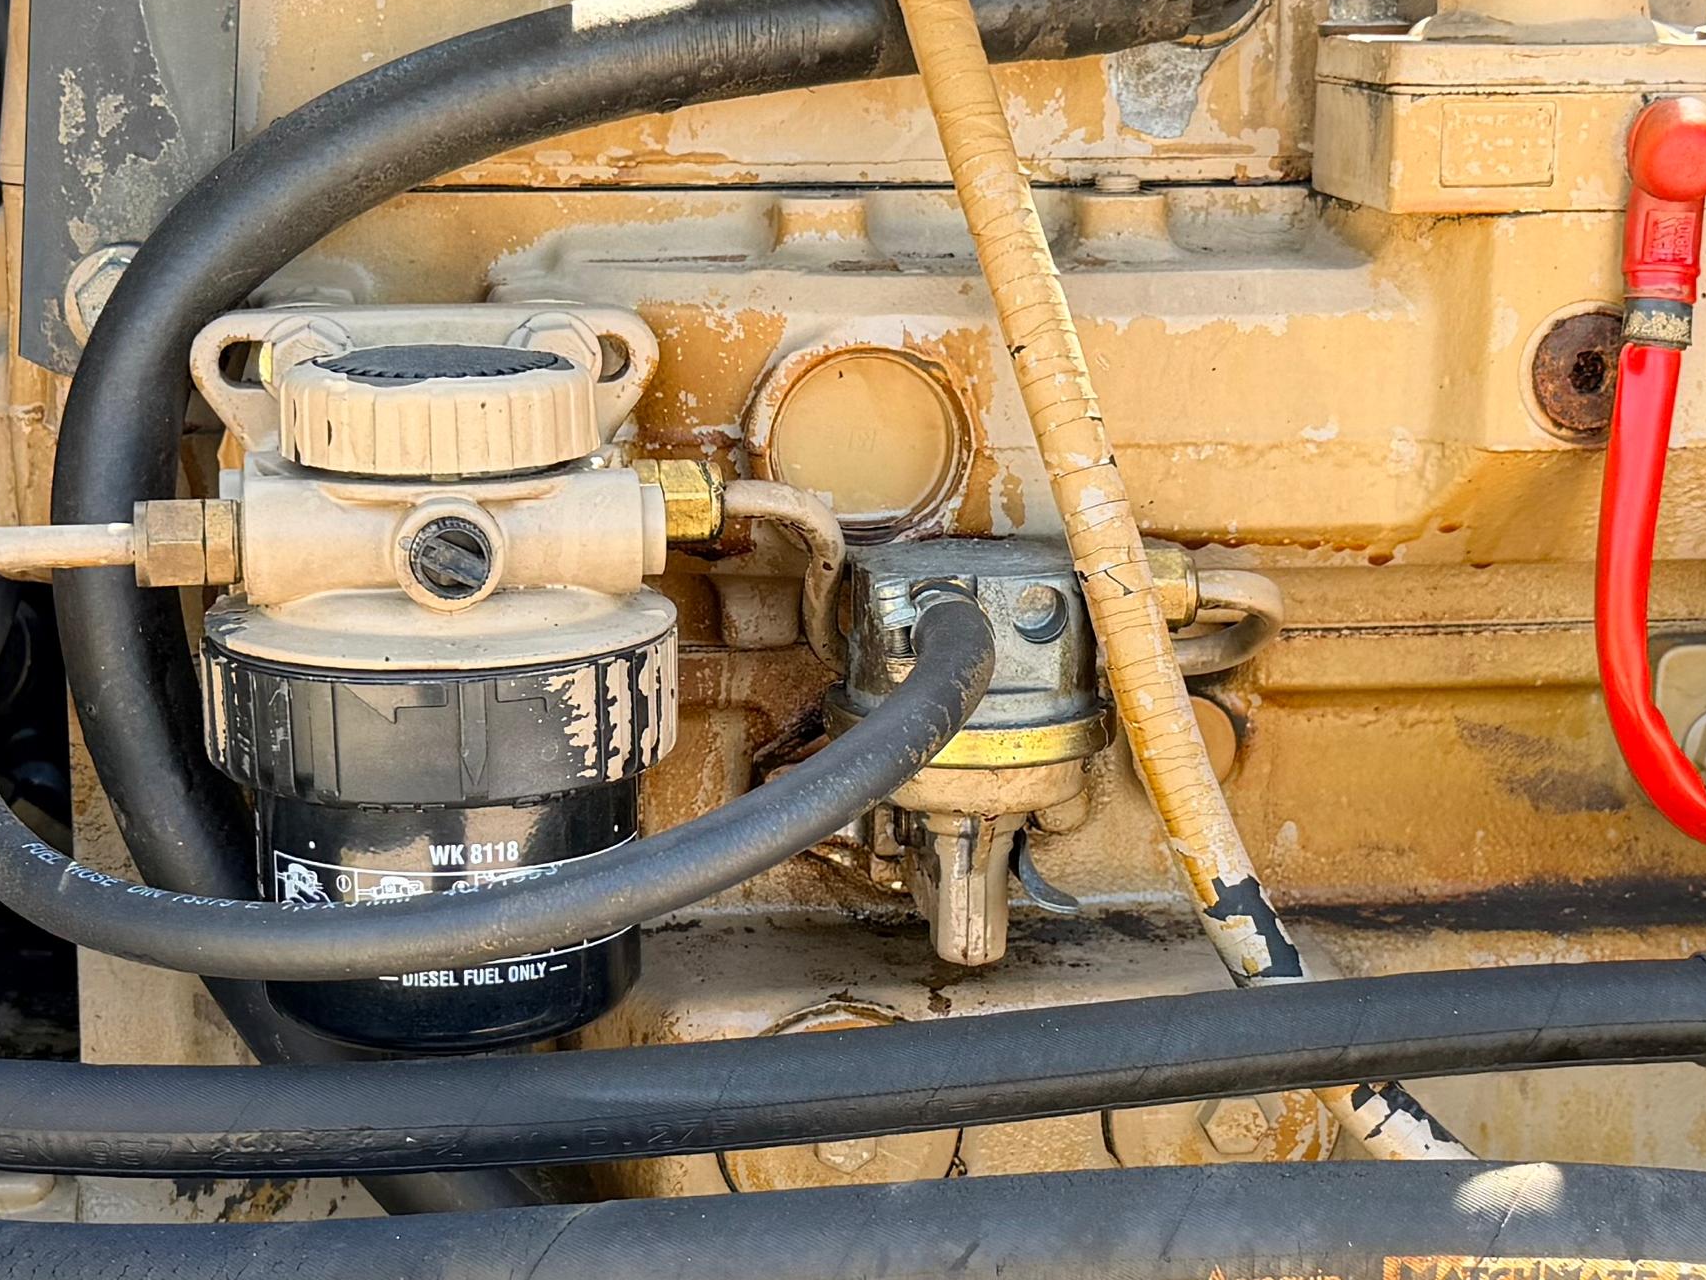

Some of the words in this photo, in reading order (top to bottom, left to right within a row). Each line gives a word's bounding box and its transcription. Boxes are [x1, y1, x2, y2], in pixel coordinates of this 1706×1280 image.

[21, 842, 63, 864] FUEL
[429, 843, 465, 867] WK
[469, 840, 520, 866] 8118
[401, 968, 459, 988] DIESEL
[463, 965, 505, 987] FUEL
[508, 960, 548, 982] ONLY
